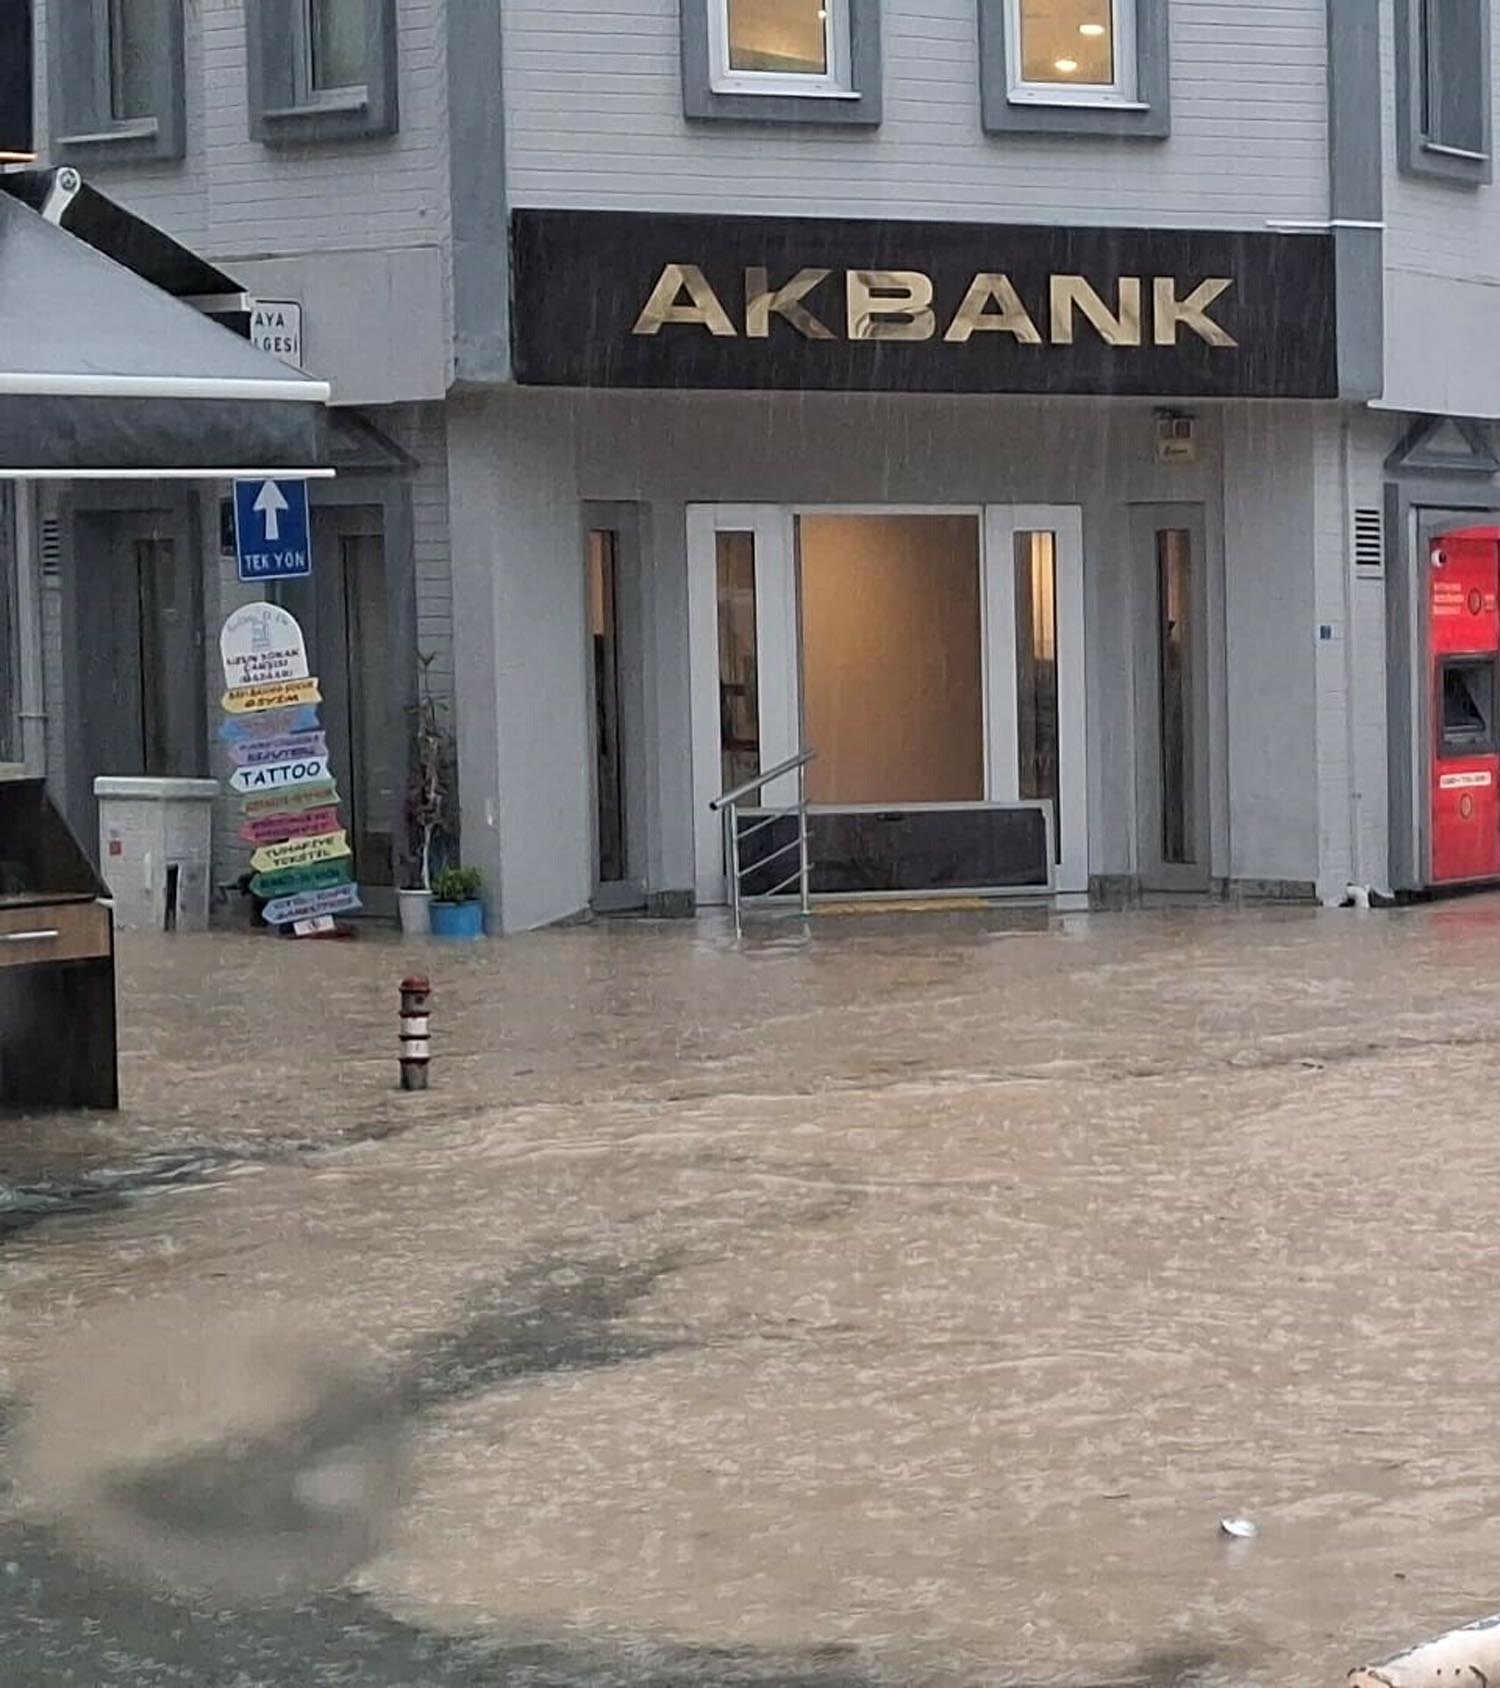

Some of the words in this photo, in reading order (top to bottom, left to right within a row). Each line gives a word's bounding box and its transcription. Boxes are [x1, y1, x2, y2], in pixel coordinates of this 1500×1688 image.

[631, 263, 1239, 347] AKBANK
[245, 554, 269, 569] TEK
[240, 762, 321, 787] TATTOO
